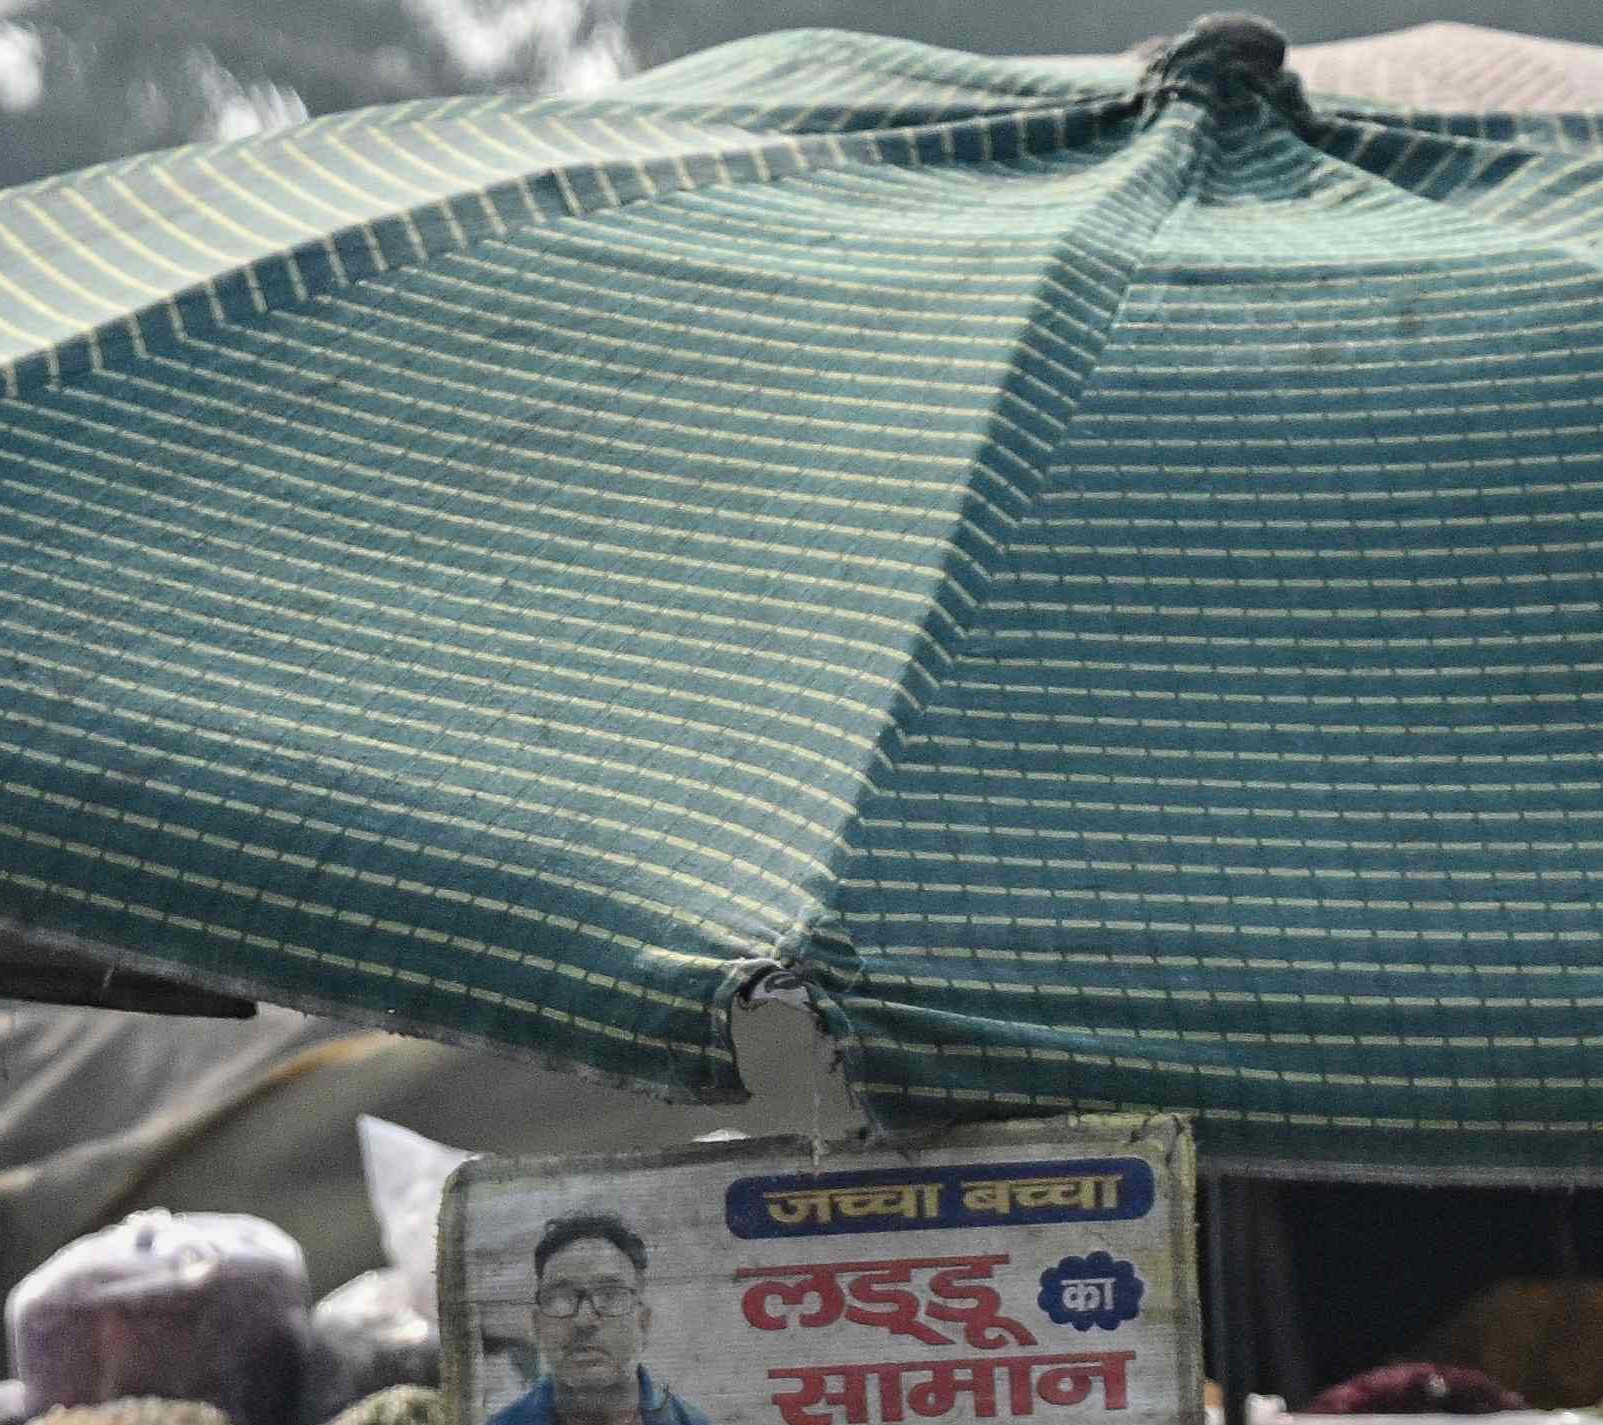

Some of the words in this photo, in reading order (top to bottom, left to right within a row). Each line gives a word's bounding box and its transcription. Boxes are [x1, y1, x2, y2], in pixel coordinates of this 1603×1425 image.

[764, 1183, 943, 1224] जच्चा
[962, 1174, 1125, 1214] बच्चा
[1061, 1277, 1117, 1313] का
